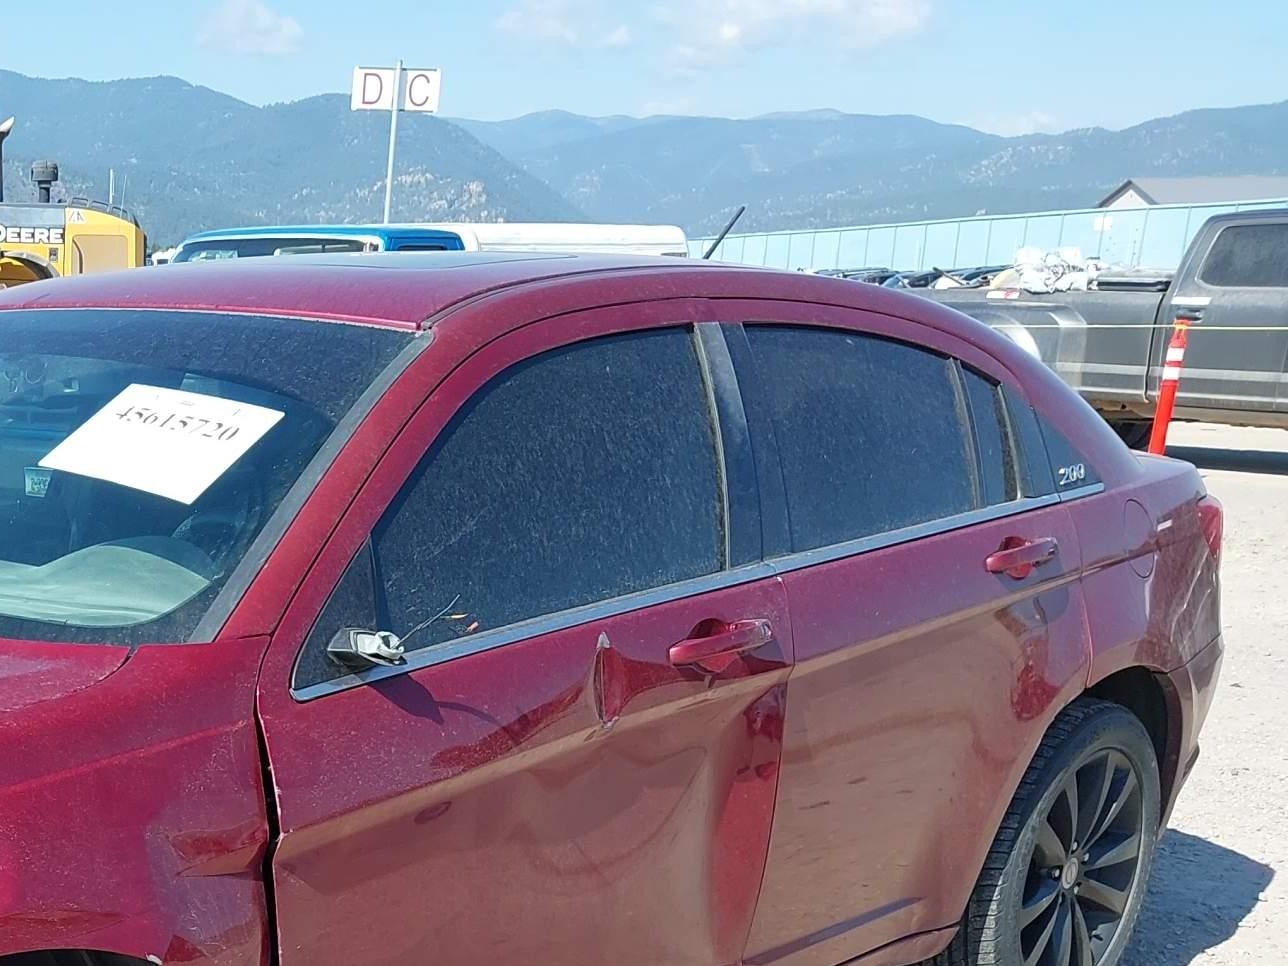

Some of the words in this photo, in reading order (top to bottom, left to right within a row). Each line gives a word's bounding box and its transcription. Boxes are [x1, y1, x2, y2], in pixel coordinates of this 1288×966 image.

[362, 72, 383, 105] D
[409, 73, 430, 107] C
[115, 405, 241, 441] 45615720
[1058, 463, 1085, 485] 200
